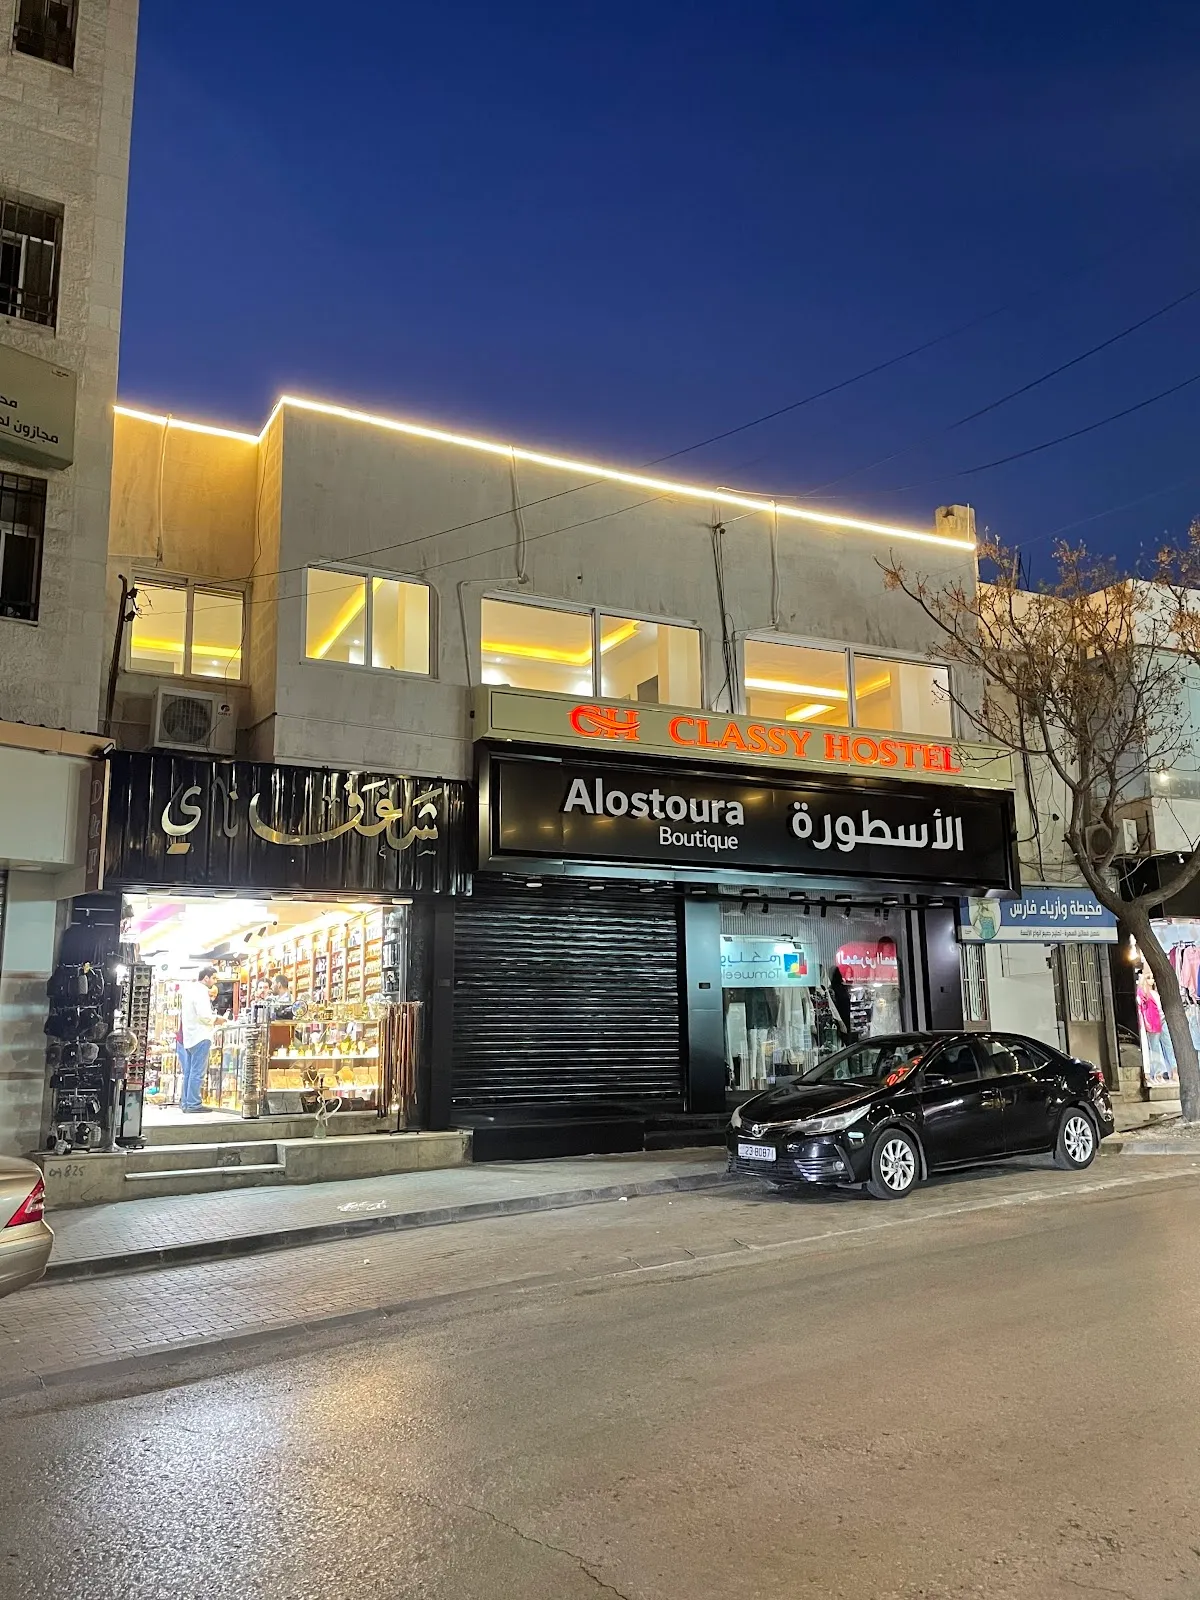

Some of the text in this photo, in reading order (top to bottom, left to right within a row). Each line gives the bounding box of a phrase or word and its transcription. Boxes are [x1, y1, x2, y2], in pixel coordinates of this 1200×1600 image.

[13, 420, 59, 444] مجازون
[567, 704, 961, 773] CH CLASSY HOSTEL
[563, 778, 744, 826] Alostoura
[660, 826, 738, 852] Boutique
[792, 800, 964, 852] الأسطورة
[1009, 899, 1037, 919] فارس
[1070, 899, 1102, 919] مخيطة
